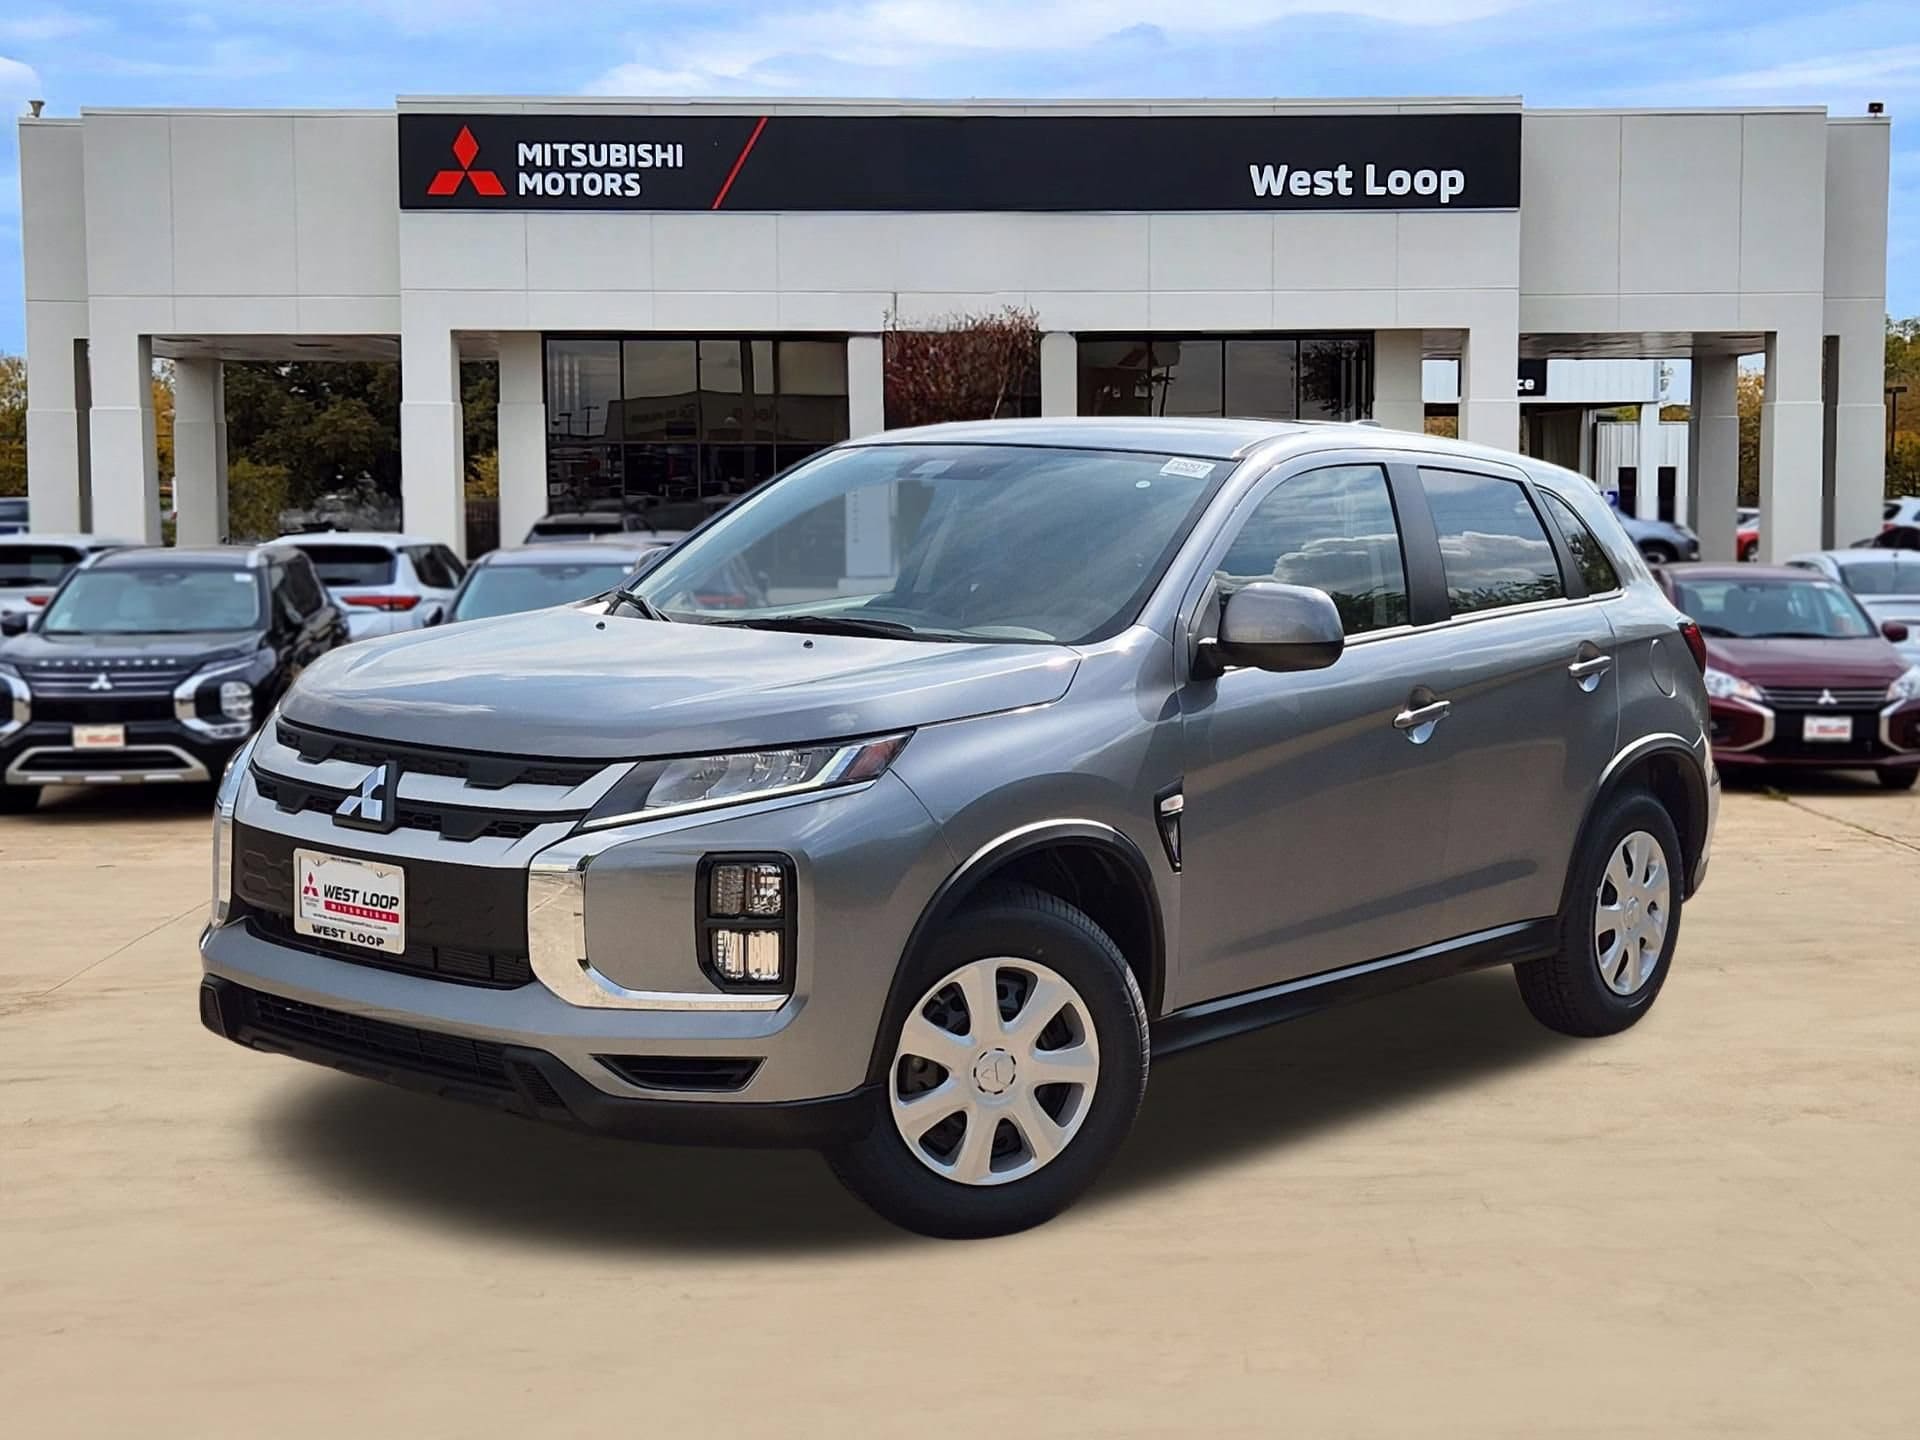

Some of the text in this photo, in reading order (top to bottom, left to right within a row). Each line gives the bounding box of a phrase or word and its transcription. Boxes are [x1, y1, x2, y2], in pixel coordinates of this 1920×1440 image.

[517, 143, 684, 168] MITSUBISHI
[518, 172, 641, 197] MOTORS
[1250, 164, 1465, 203] West Loop
[323, 884, 359, 903] WEST
[362, 891, 399, 910] LOOP
[312, 924, 384, 946] WEST LOOP
